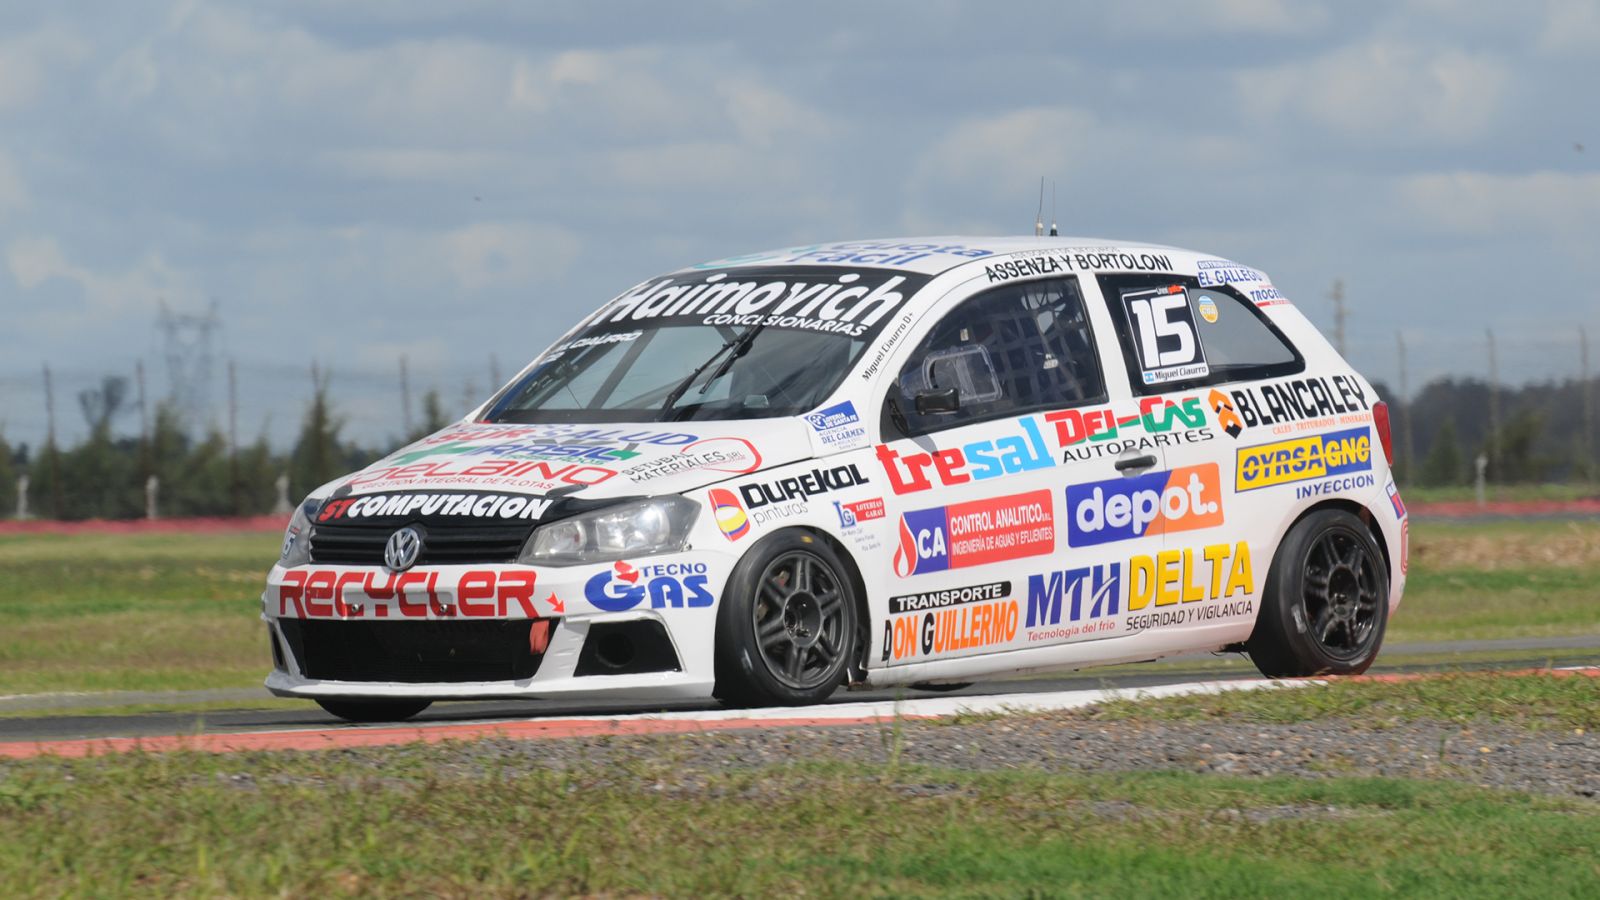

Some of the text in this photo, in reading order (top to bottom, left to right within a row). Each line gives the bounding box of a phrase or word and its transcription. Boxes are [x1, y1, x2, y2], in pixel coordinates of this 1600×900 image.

[985, 253, 1174, 283] ASSENZA Y BORTOLONI
[1198, 272, 1213, 286] EL
[587, 273, 906, 327] Haimovich
[1131, 294, 1196, 369] 15
[862, 350, 885, 381] Miguel
[881, 323, 907, 353] Ciaurro
[1154, 366, 1207, 380] Miguel Ciaurro
[1230, 375, 1369, 428] BLANCALEY
[875, 416, 1056, 496] tresal
[1063, 428, 1214, 464] AUTOPARTES
[621, 451, 695, 476] SETUBAL
[630, 451, 727, 484] MATERIALES
[419, 476, 477, 484] INTEGRAL
[482, 477, 499, 485] DE
[502, 478, 555, 490] FLOTAS
[739, 463, 869, 510] DUREKOL
[1296, 474, 1375, 499] INYECCION
[753, 502, 808, 527] pinturas
[951, 511, 994, 536] CONTROL
[995, 503, 1042, 529] ANALITICO
[917, 525, 947, 560] CA
[986, 536, 994, 550] DE
[995, 532, 1015, 549] AGUAS
[1015, 531, 1021, 545] Y
[1020, 526, 1053, 545] EFLUENTES
[640, 563, 707, 577] TECNO
[1128, 540, 1255, 612] DELTA
[584, 569, 714, 612] GAS
[897, 584, 1002, 611] TRANSPORTE
[882, 600, 1019, 661] DON GUILLERMO
[1082, 623, 1097, 635] del
[1126, 600, 1253, 631] SEGURIDAD Y VIGILANCIA
